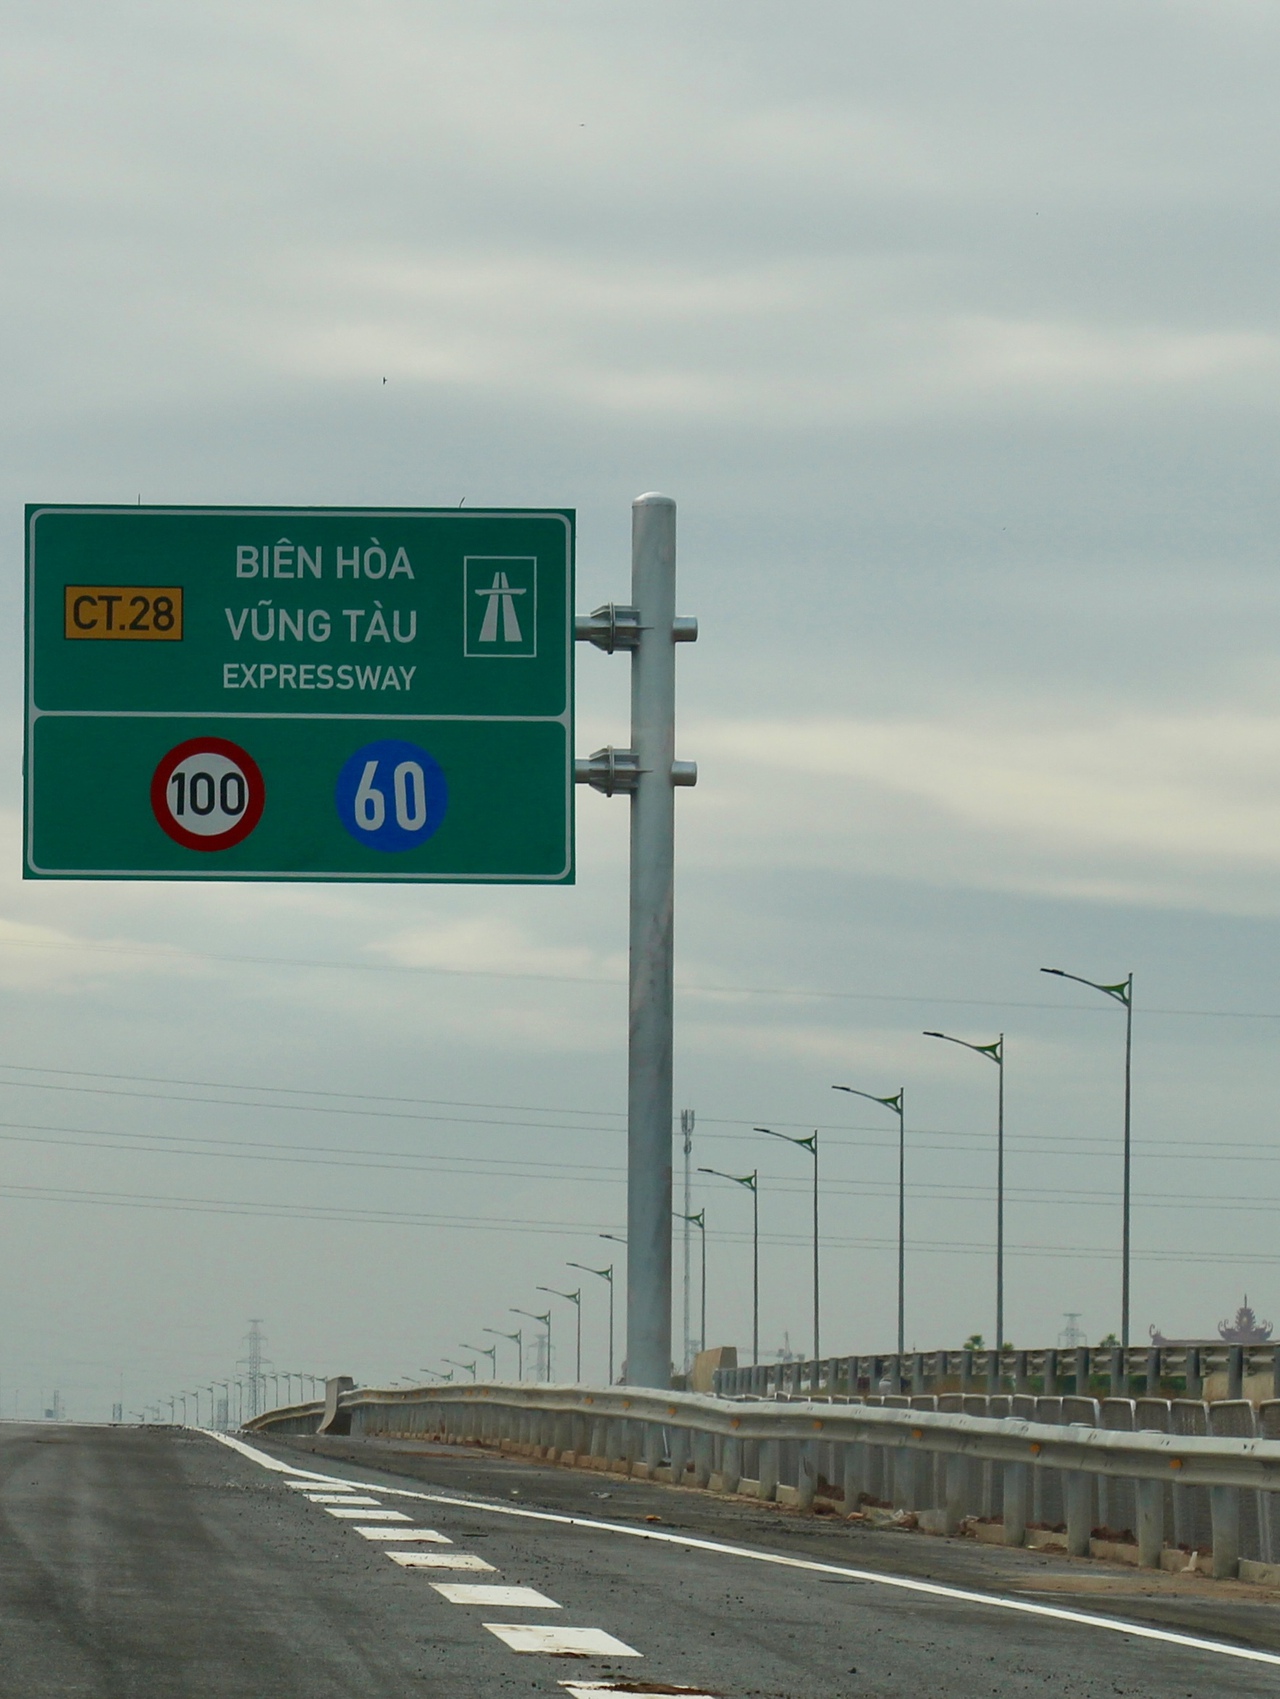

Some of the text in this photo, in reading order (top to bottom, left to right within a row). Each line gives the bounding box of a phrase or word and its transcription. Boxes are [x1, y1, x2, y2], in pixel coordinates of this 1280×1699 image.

[235, 536, 415, 580] BIÊN HÒA
[72, 594, 175, 632] CT.28
[224, 599, 417, 643] VŨNG TÀU
[223, 663, 417, 691] EXPRESSWAY
[171, 771, 247, 816] 100
[354, 760, 427, 832] 60
